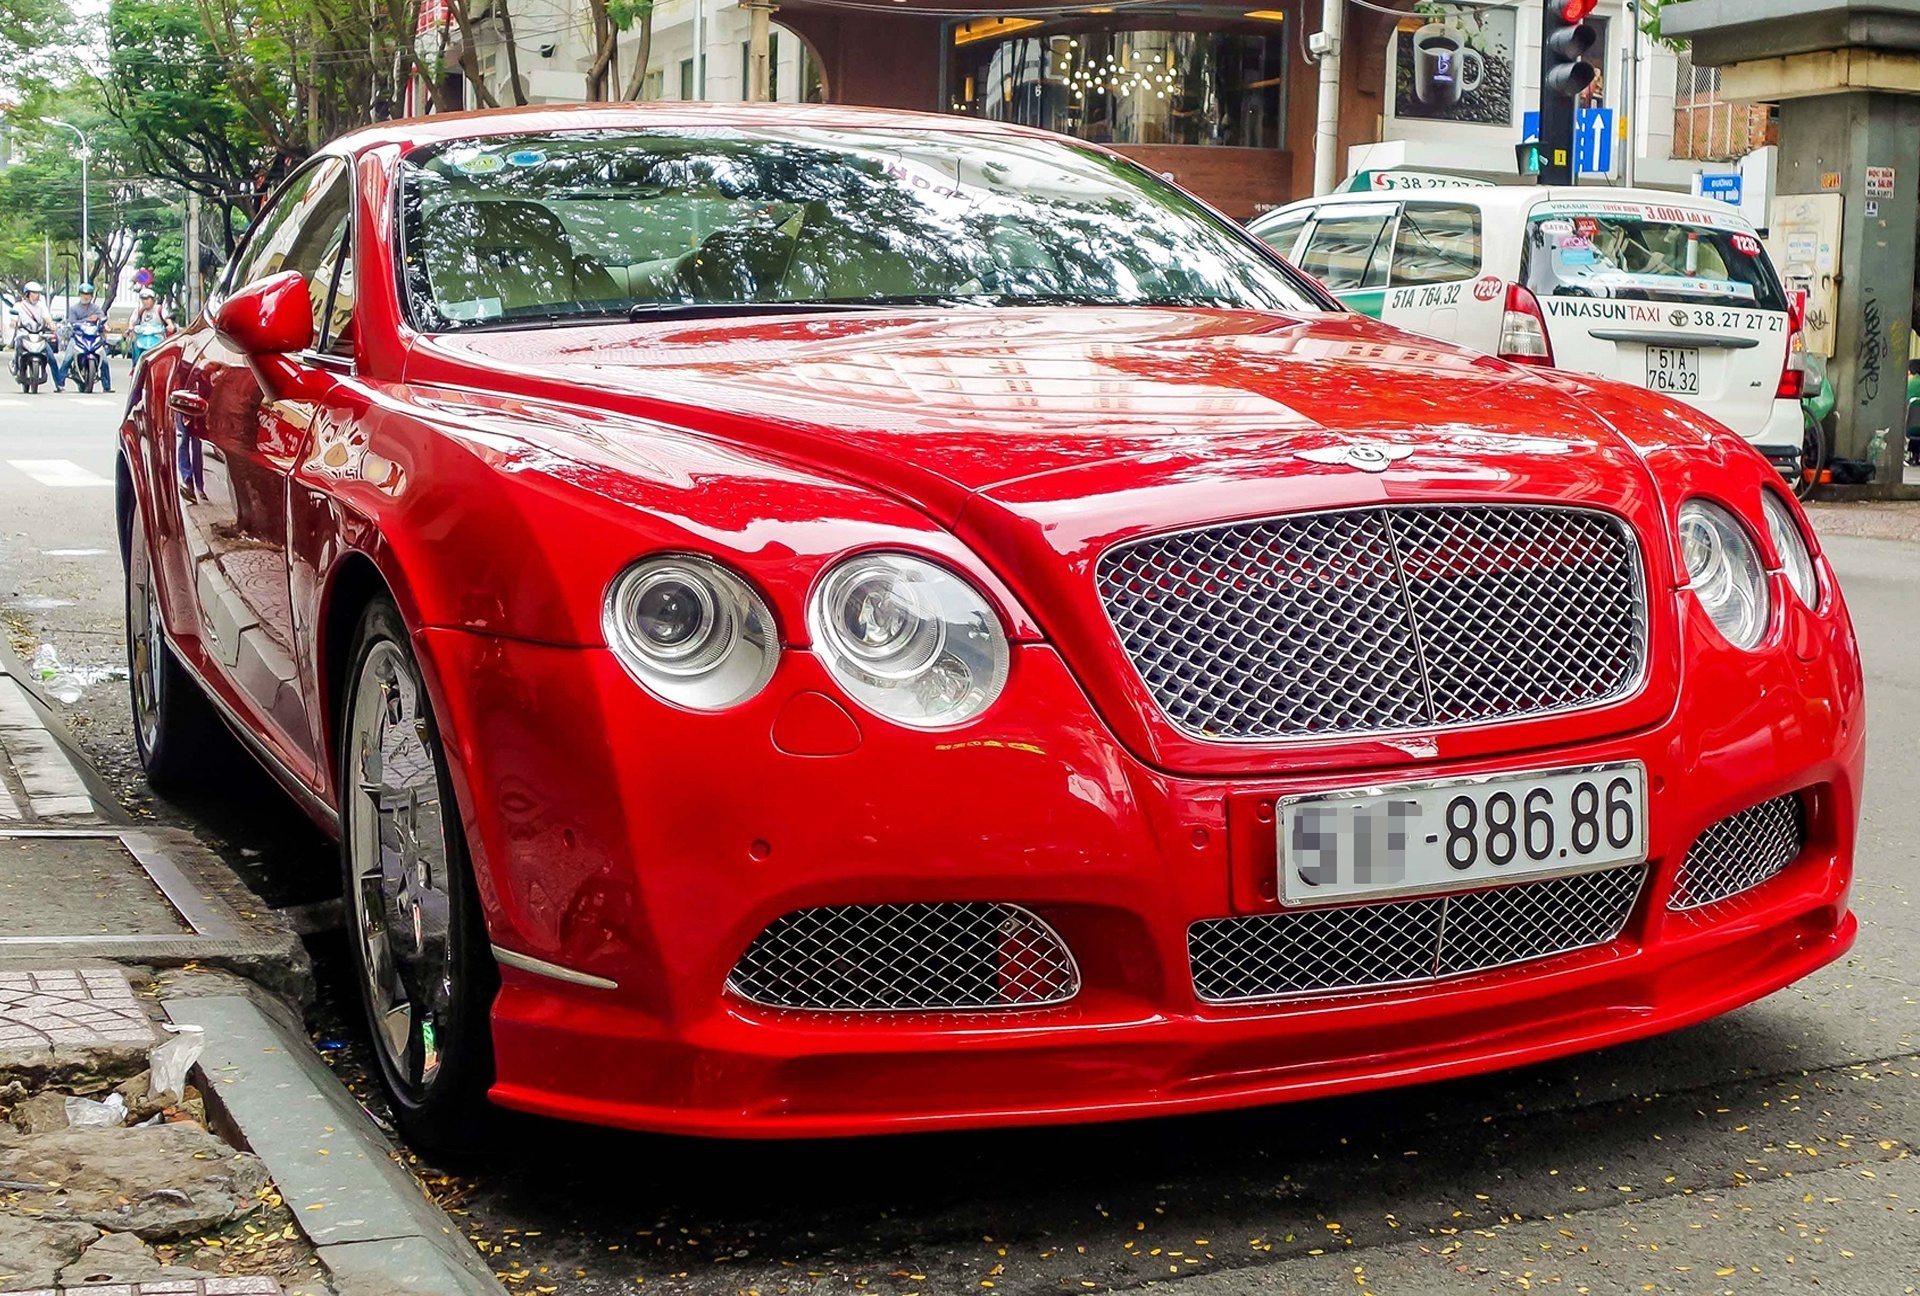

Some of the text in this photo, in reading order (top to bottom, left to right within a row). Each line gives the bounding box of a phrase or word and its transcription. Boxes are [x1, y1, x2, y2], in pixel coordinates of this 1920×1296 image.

[1401, 177, 1421, 189] 38
[1645, 206, 1685, 222] 3.000
[1733, 235, 1760, 254] 7232
[1392, 284, 1461, 309] 51A 764.32
[1475, 281, 1501, 297] 7232
[1547, 302, 1784, 332] VINASUNTAXI 38.27 27 27
[1659, 350, 1686, 370] 51A
[1649, 370, 1698, 392] 764.32
[1292, 776, 1633, 886] -886.86
